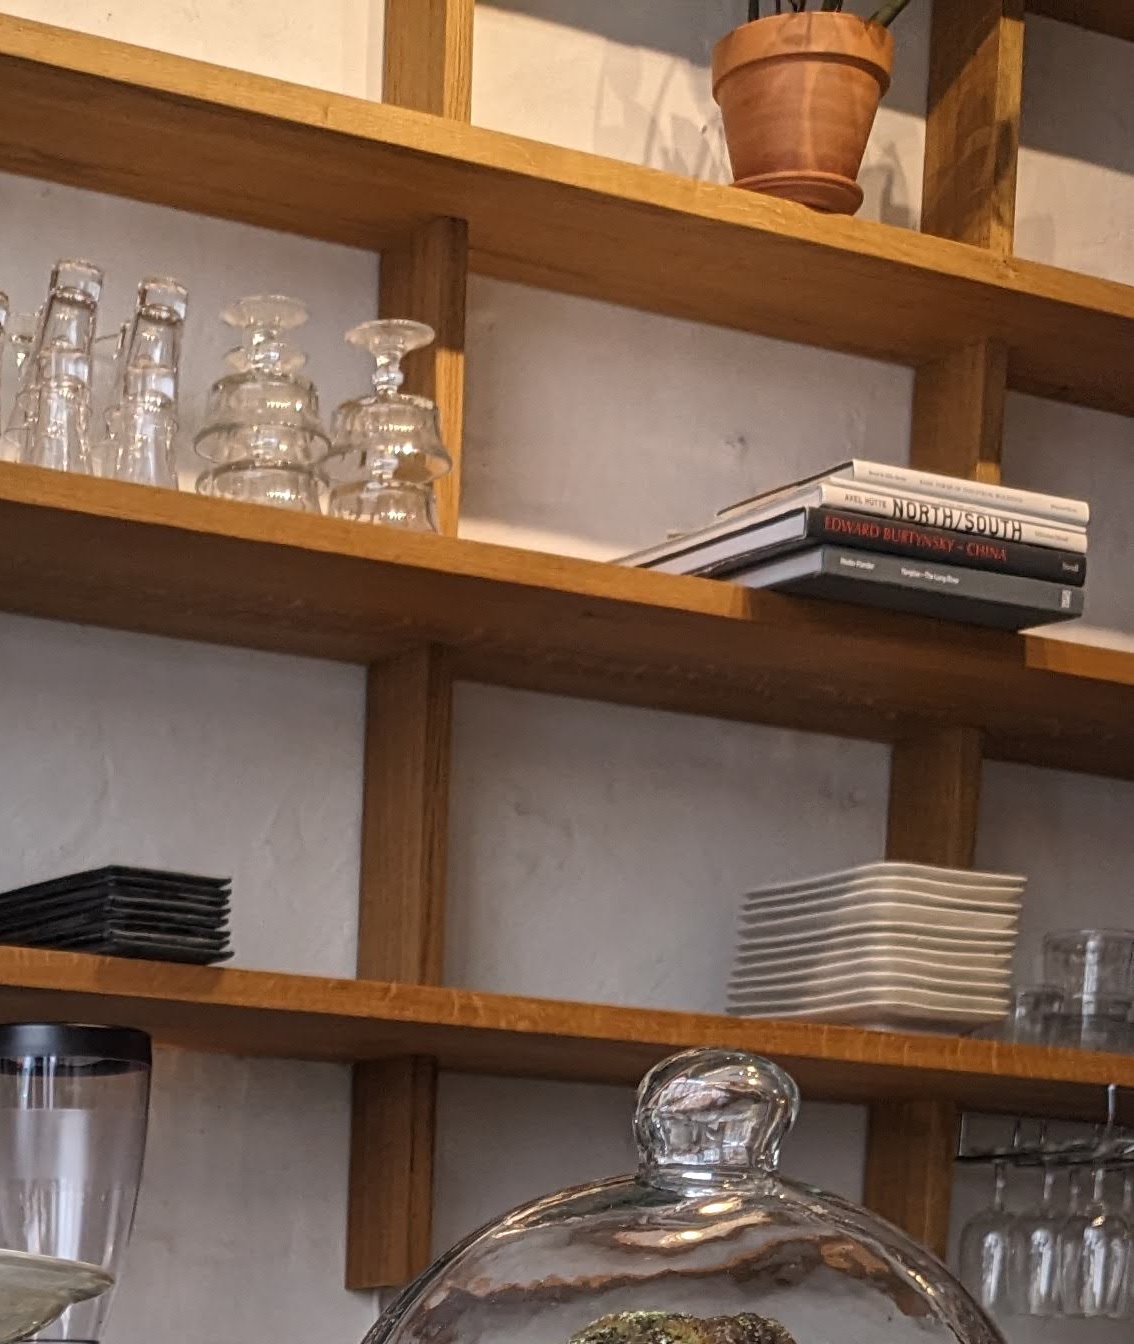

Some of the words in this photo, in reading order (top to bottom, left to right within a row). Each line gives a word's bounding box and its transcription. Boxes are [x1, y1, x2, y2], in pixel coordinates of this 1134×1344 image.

[824, 515, 880, 538] EDWARD
[883, 527, 956, 553] BURTYNSKY
[966, 543, 1008, 562] CHINA
[892, 498, 1023, 541] NORTH/SOUTH
